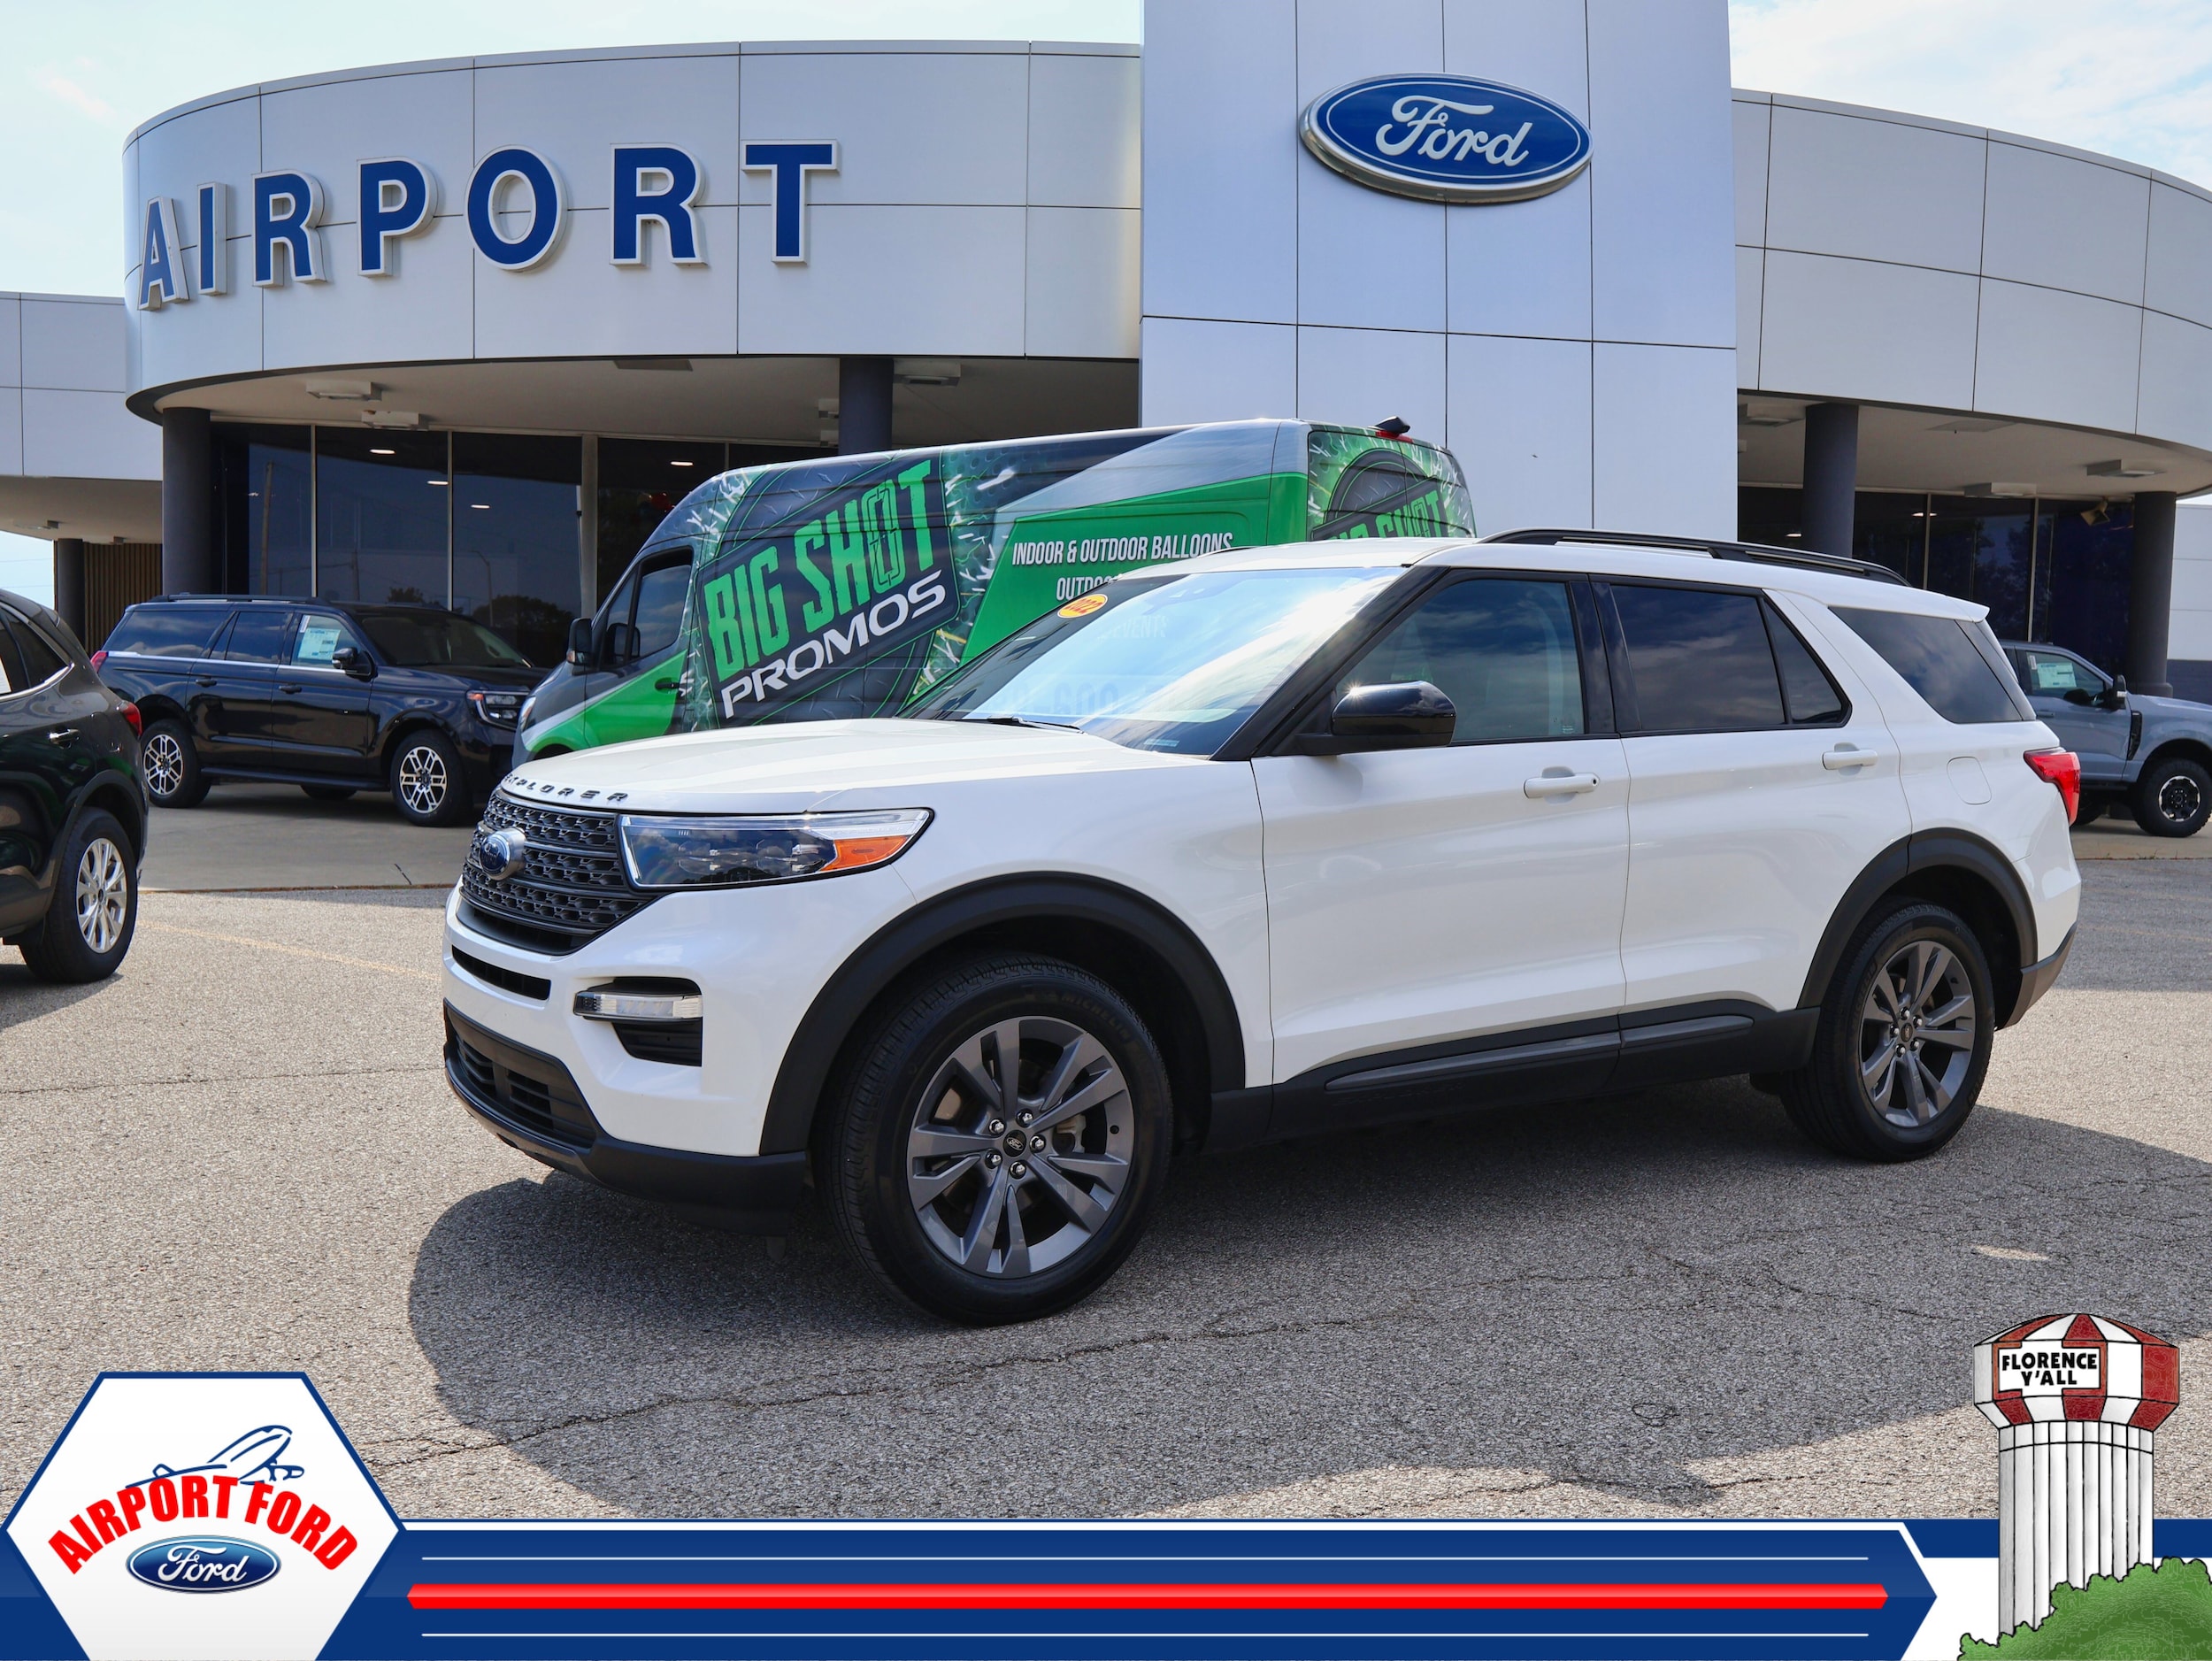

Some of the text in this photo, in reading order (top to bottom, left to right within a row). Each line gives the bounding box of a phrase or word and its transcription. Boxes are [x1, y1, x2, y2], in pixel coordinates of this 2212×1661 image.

[1375, 95, 1533, 166] Ford
[137, 139, 841, 311] AIRPORT
[703, 459, 936, 683] BIG SHOT
[1011, 532, 1233, 565] INDOOR & OUTDOOR BALLOONS
[721, 569, 947, 719] PROMOS
